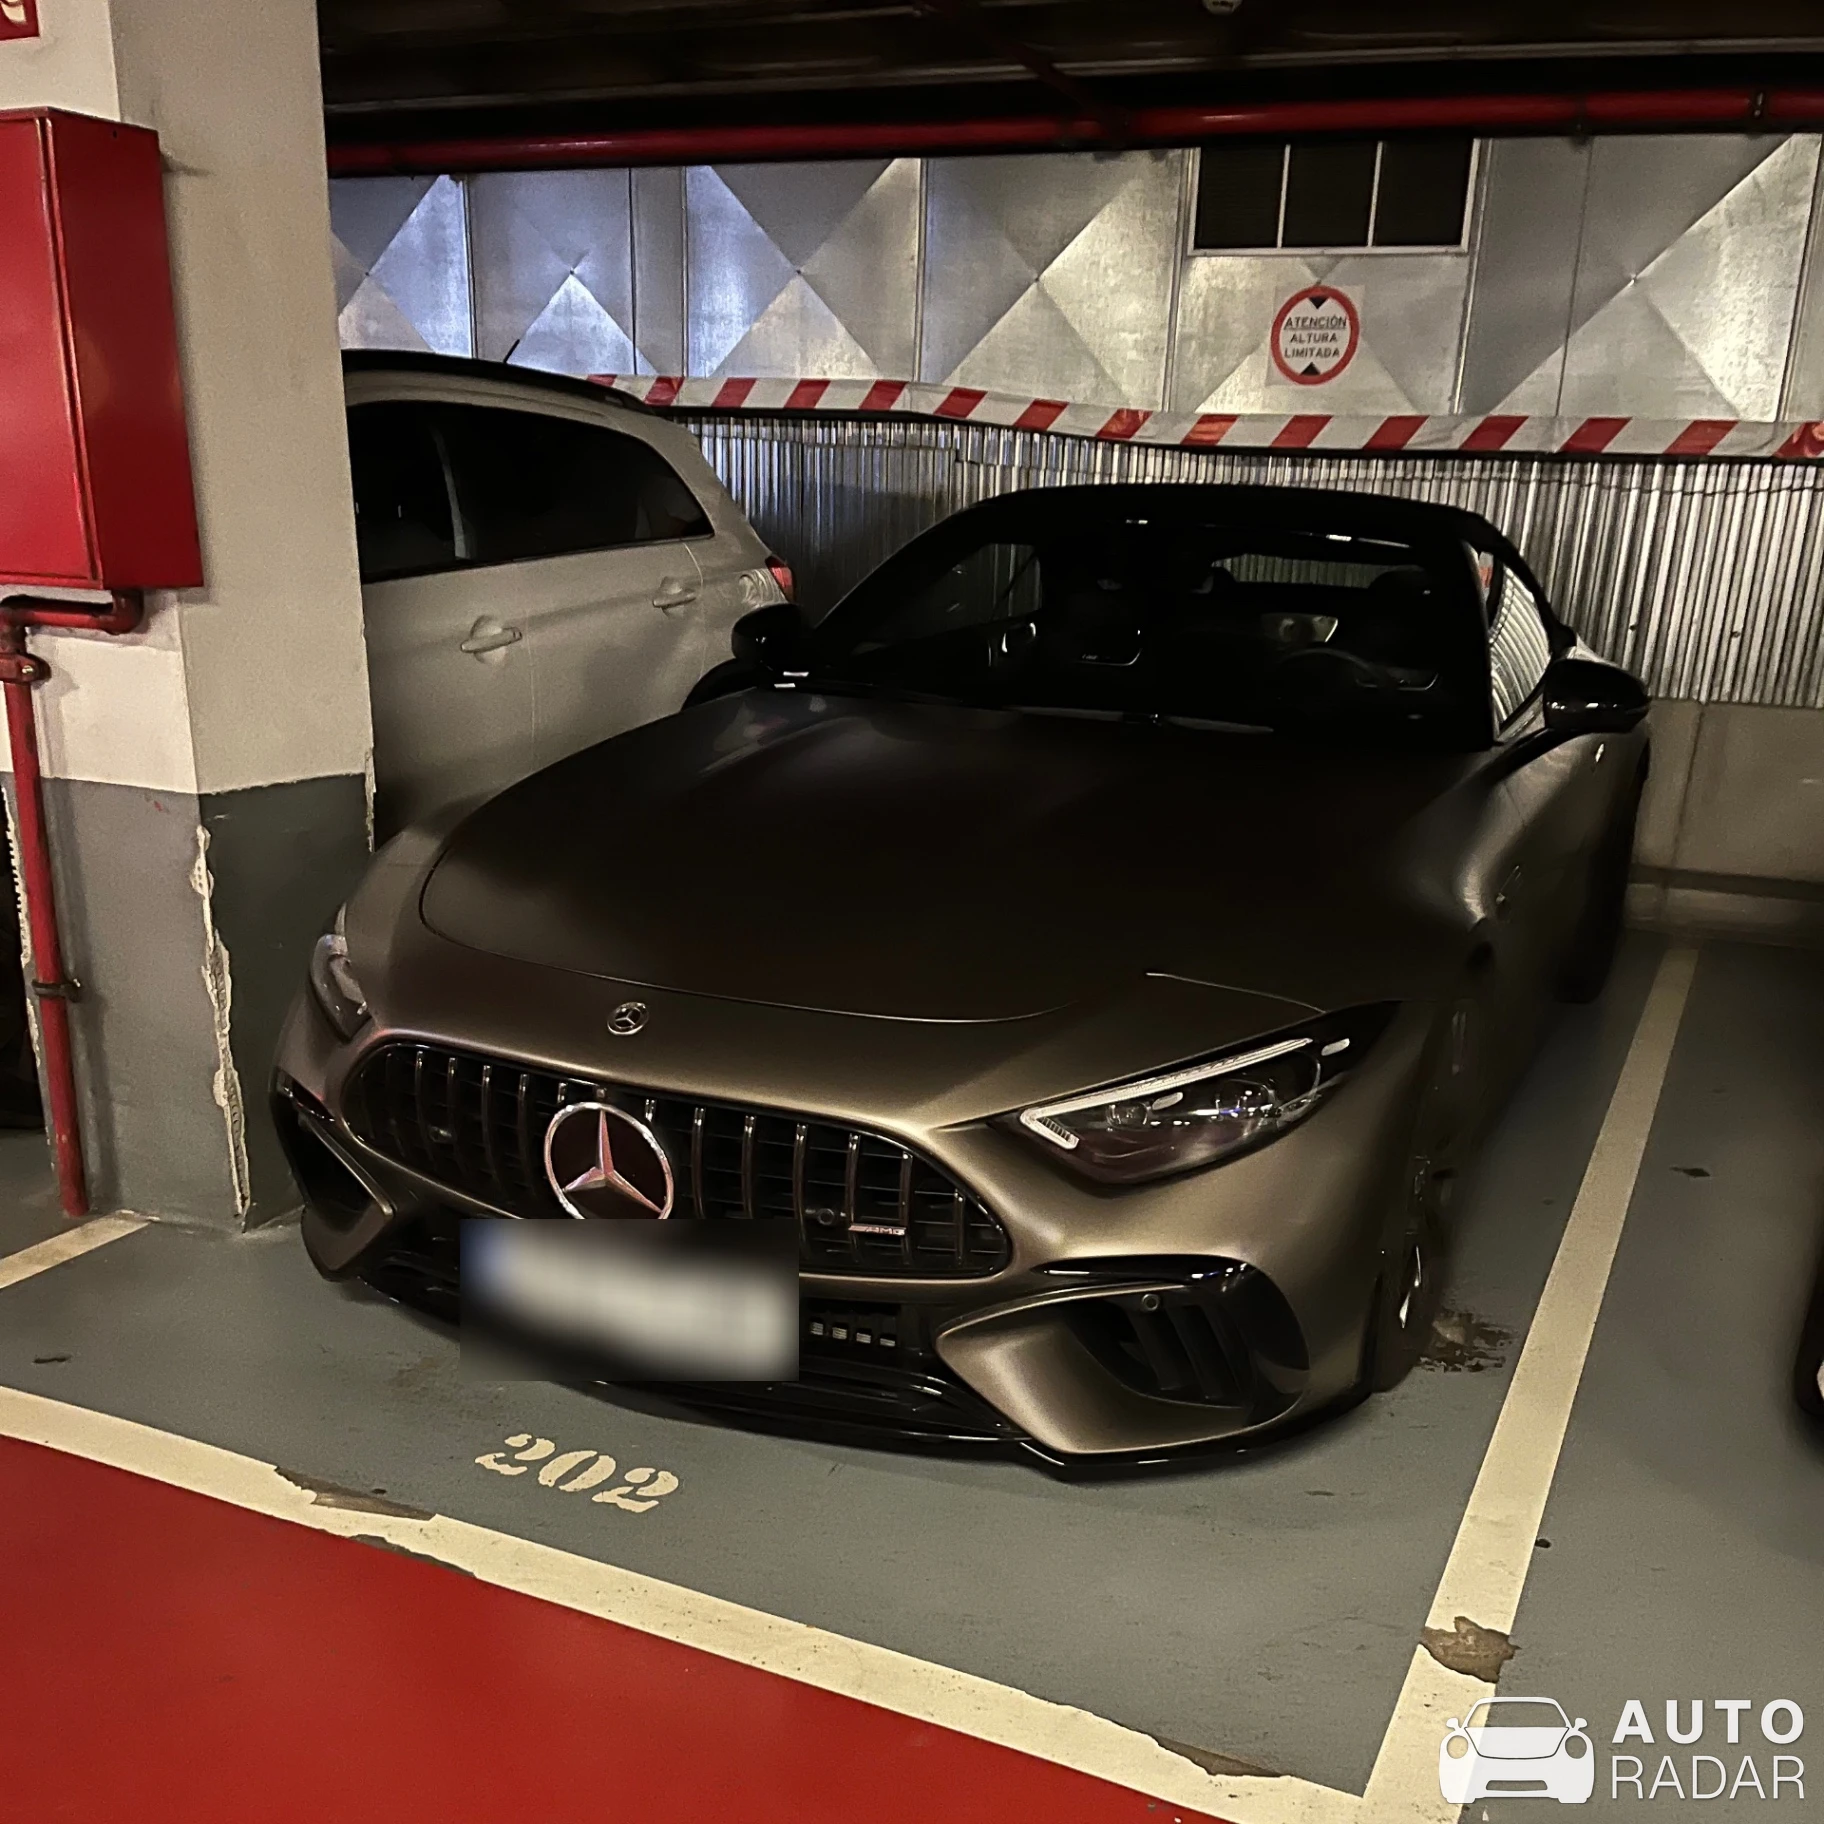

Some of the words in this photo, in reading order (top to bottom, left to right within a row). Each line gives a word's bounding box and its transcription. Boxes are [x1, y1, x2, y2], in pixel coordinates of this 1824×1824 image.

[1284, 314, 1347, 330] ATENCIÓN
[1289, 332, 1338, 344] ALTURA
[1284, 347, 1340, 359] LIMITADA
[474, 1433, 679, 1514] 202
